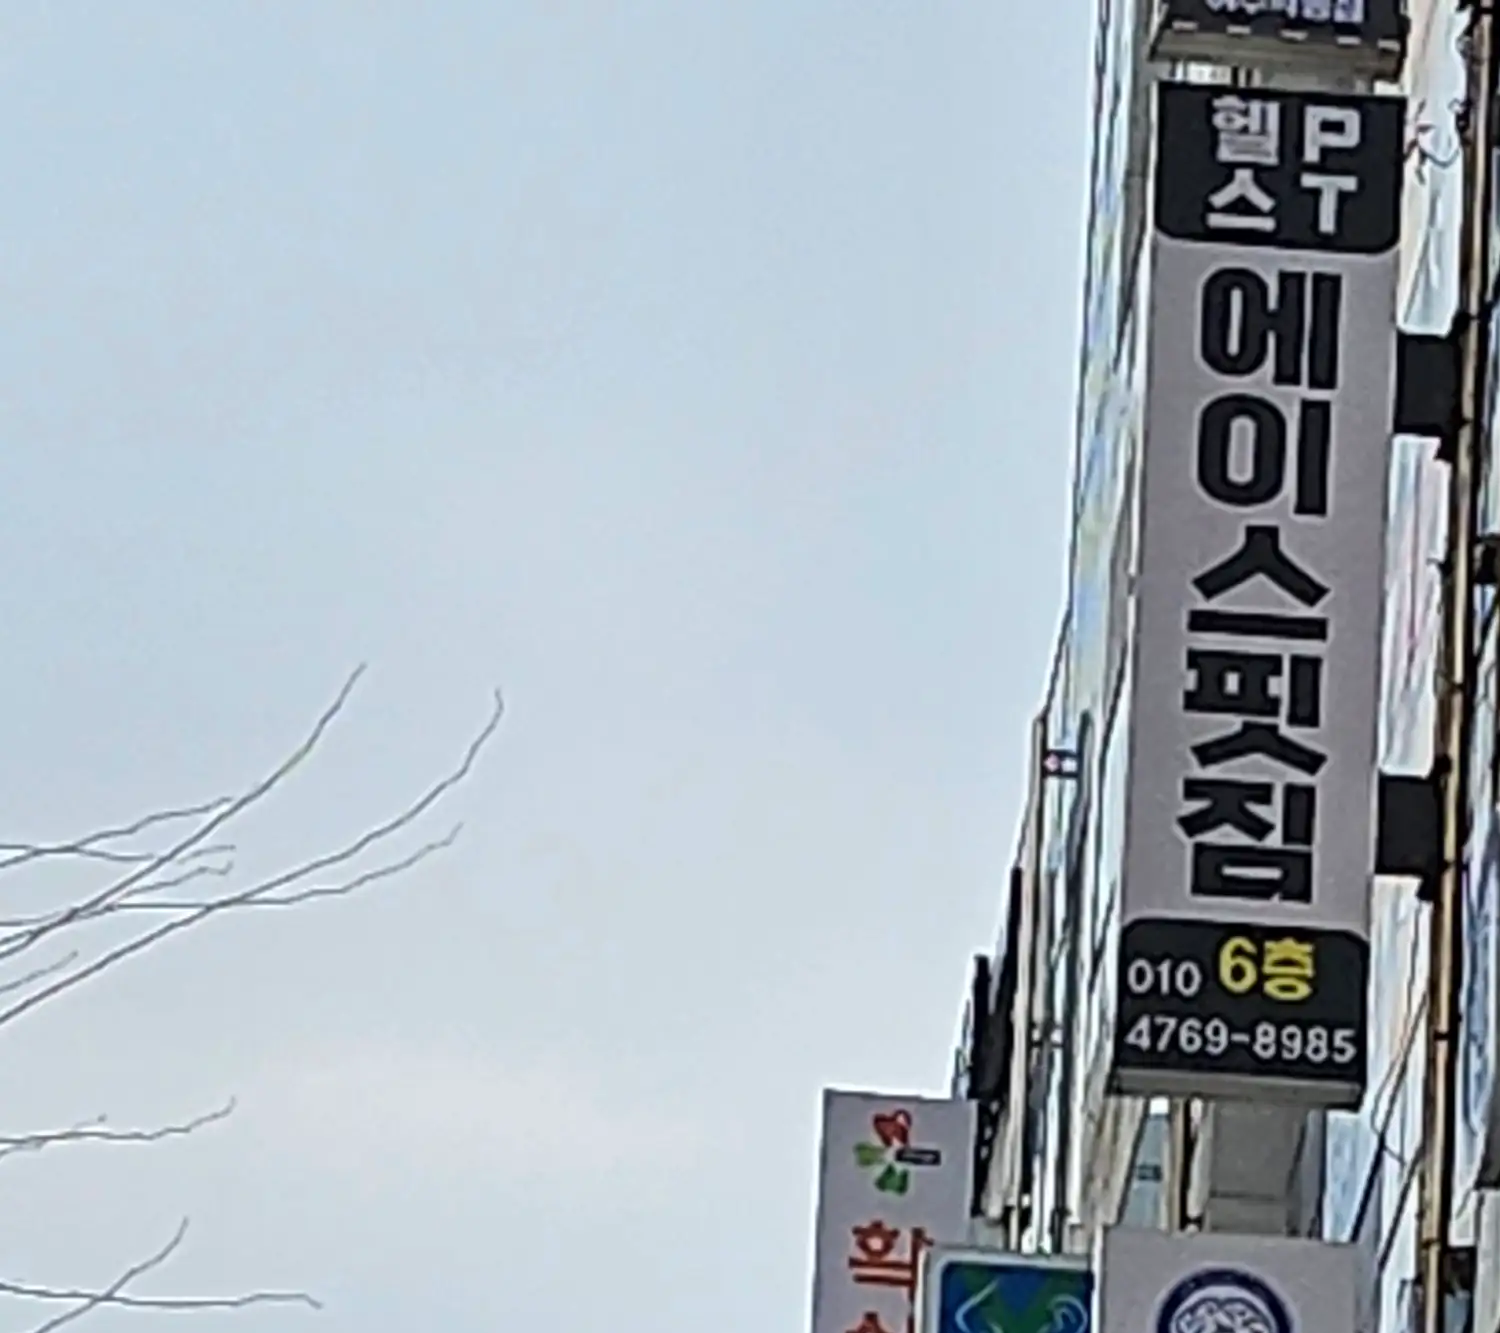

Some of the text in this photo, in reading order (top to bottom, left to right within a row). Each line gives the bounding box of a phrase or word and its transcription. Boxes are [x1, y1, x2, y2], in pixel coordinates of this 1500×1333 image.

[1176, 266, 1342, 904] 에이스핏짐
[1127, 957, 1202, 997] 010
[1218, 936, 1316, 1001] 6층
[1124, 1015, 1358, 1064] 4769-8985
